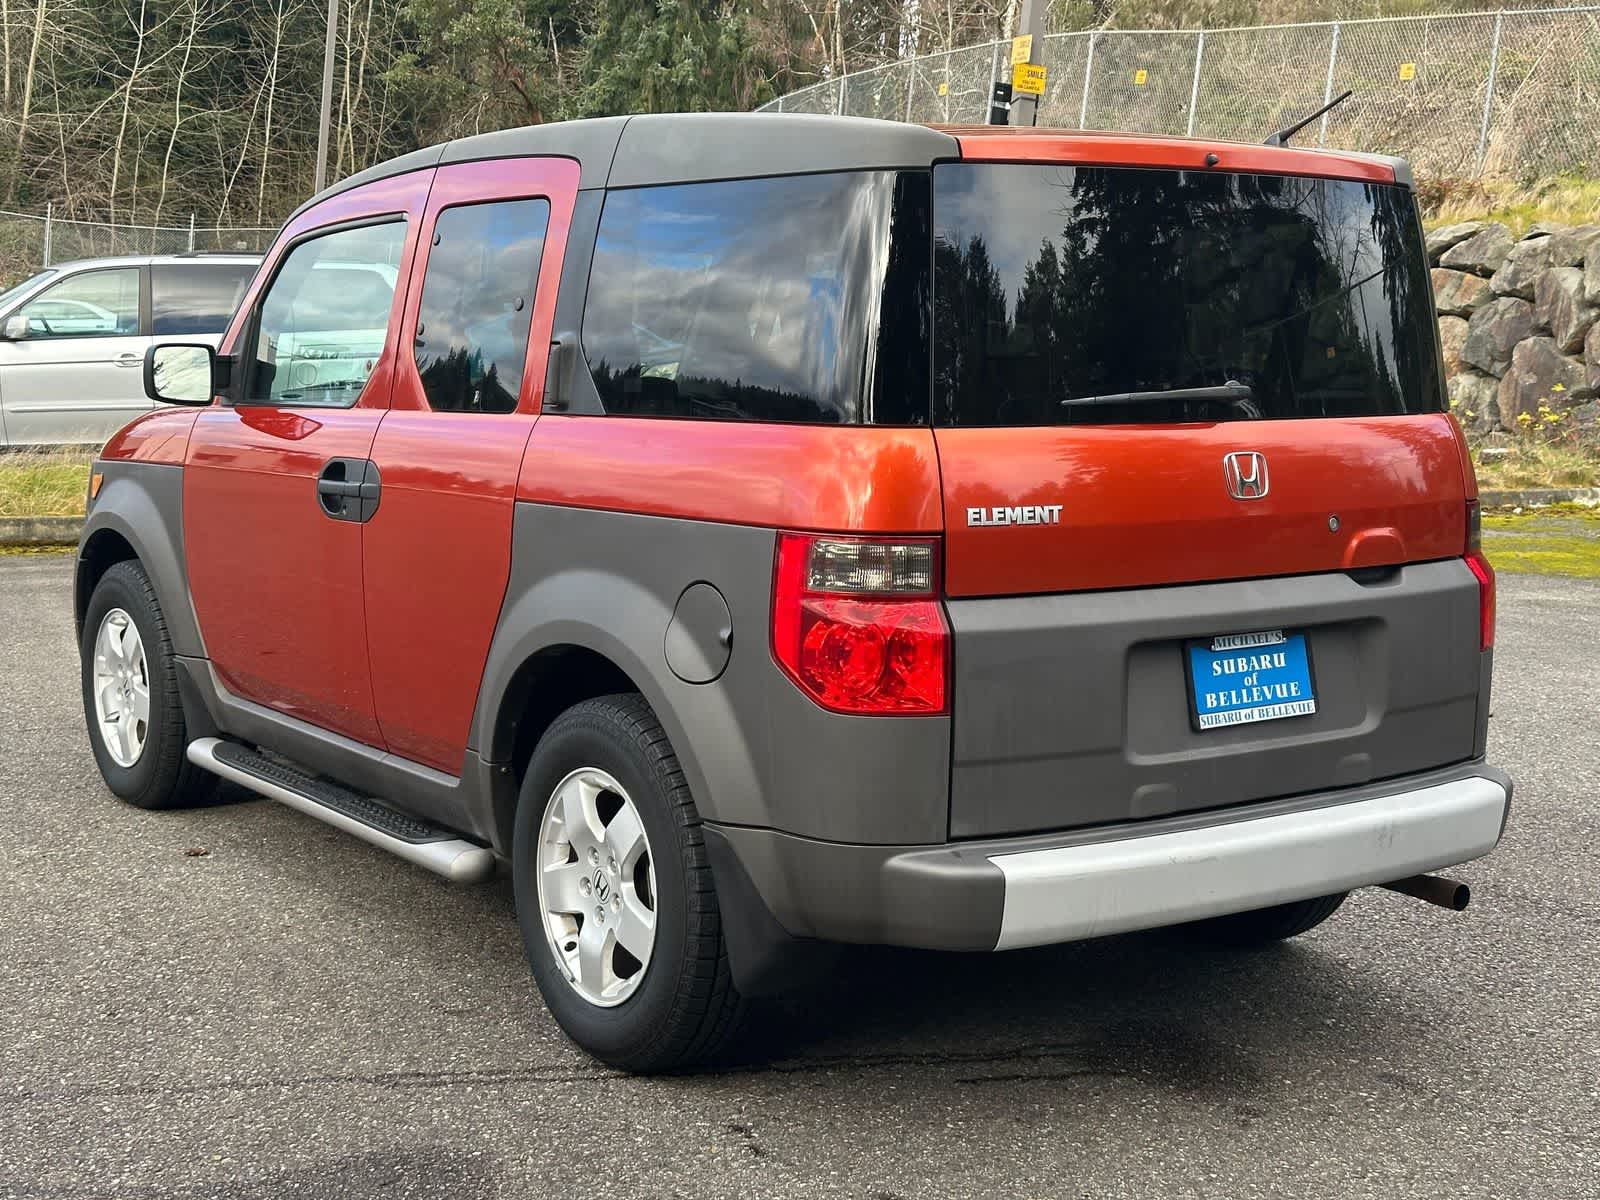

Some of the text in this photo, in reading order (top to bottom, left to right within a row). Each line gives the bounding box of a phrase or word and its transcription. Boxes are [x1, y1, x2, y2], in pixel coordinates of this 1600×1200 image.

[1027, 69, 1044, 80] SMILE
[967, 505, 1063, 526] ELEMENT
[1215, 632, 1282, 649] MICHAEL'S
[1212, 652, 1286, 676] SUBARU
[1244, 672, 1258, 687] of
[1205, 681, 1301, 708] BELLEVUE
[1200, 701, 1315, 726] SUBARU of BELLEVUE
